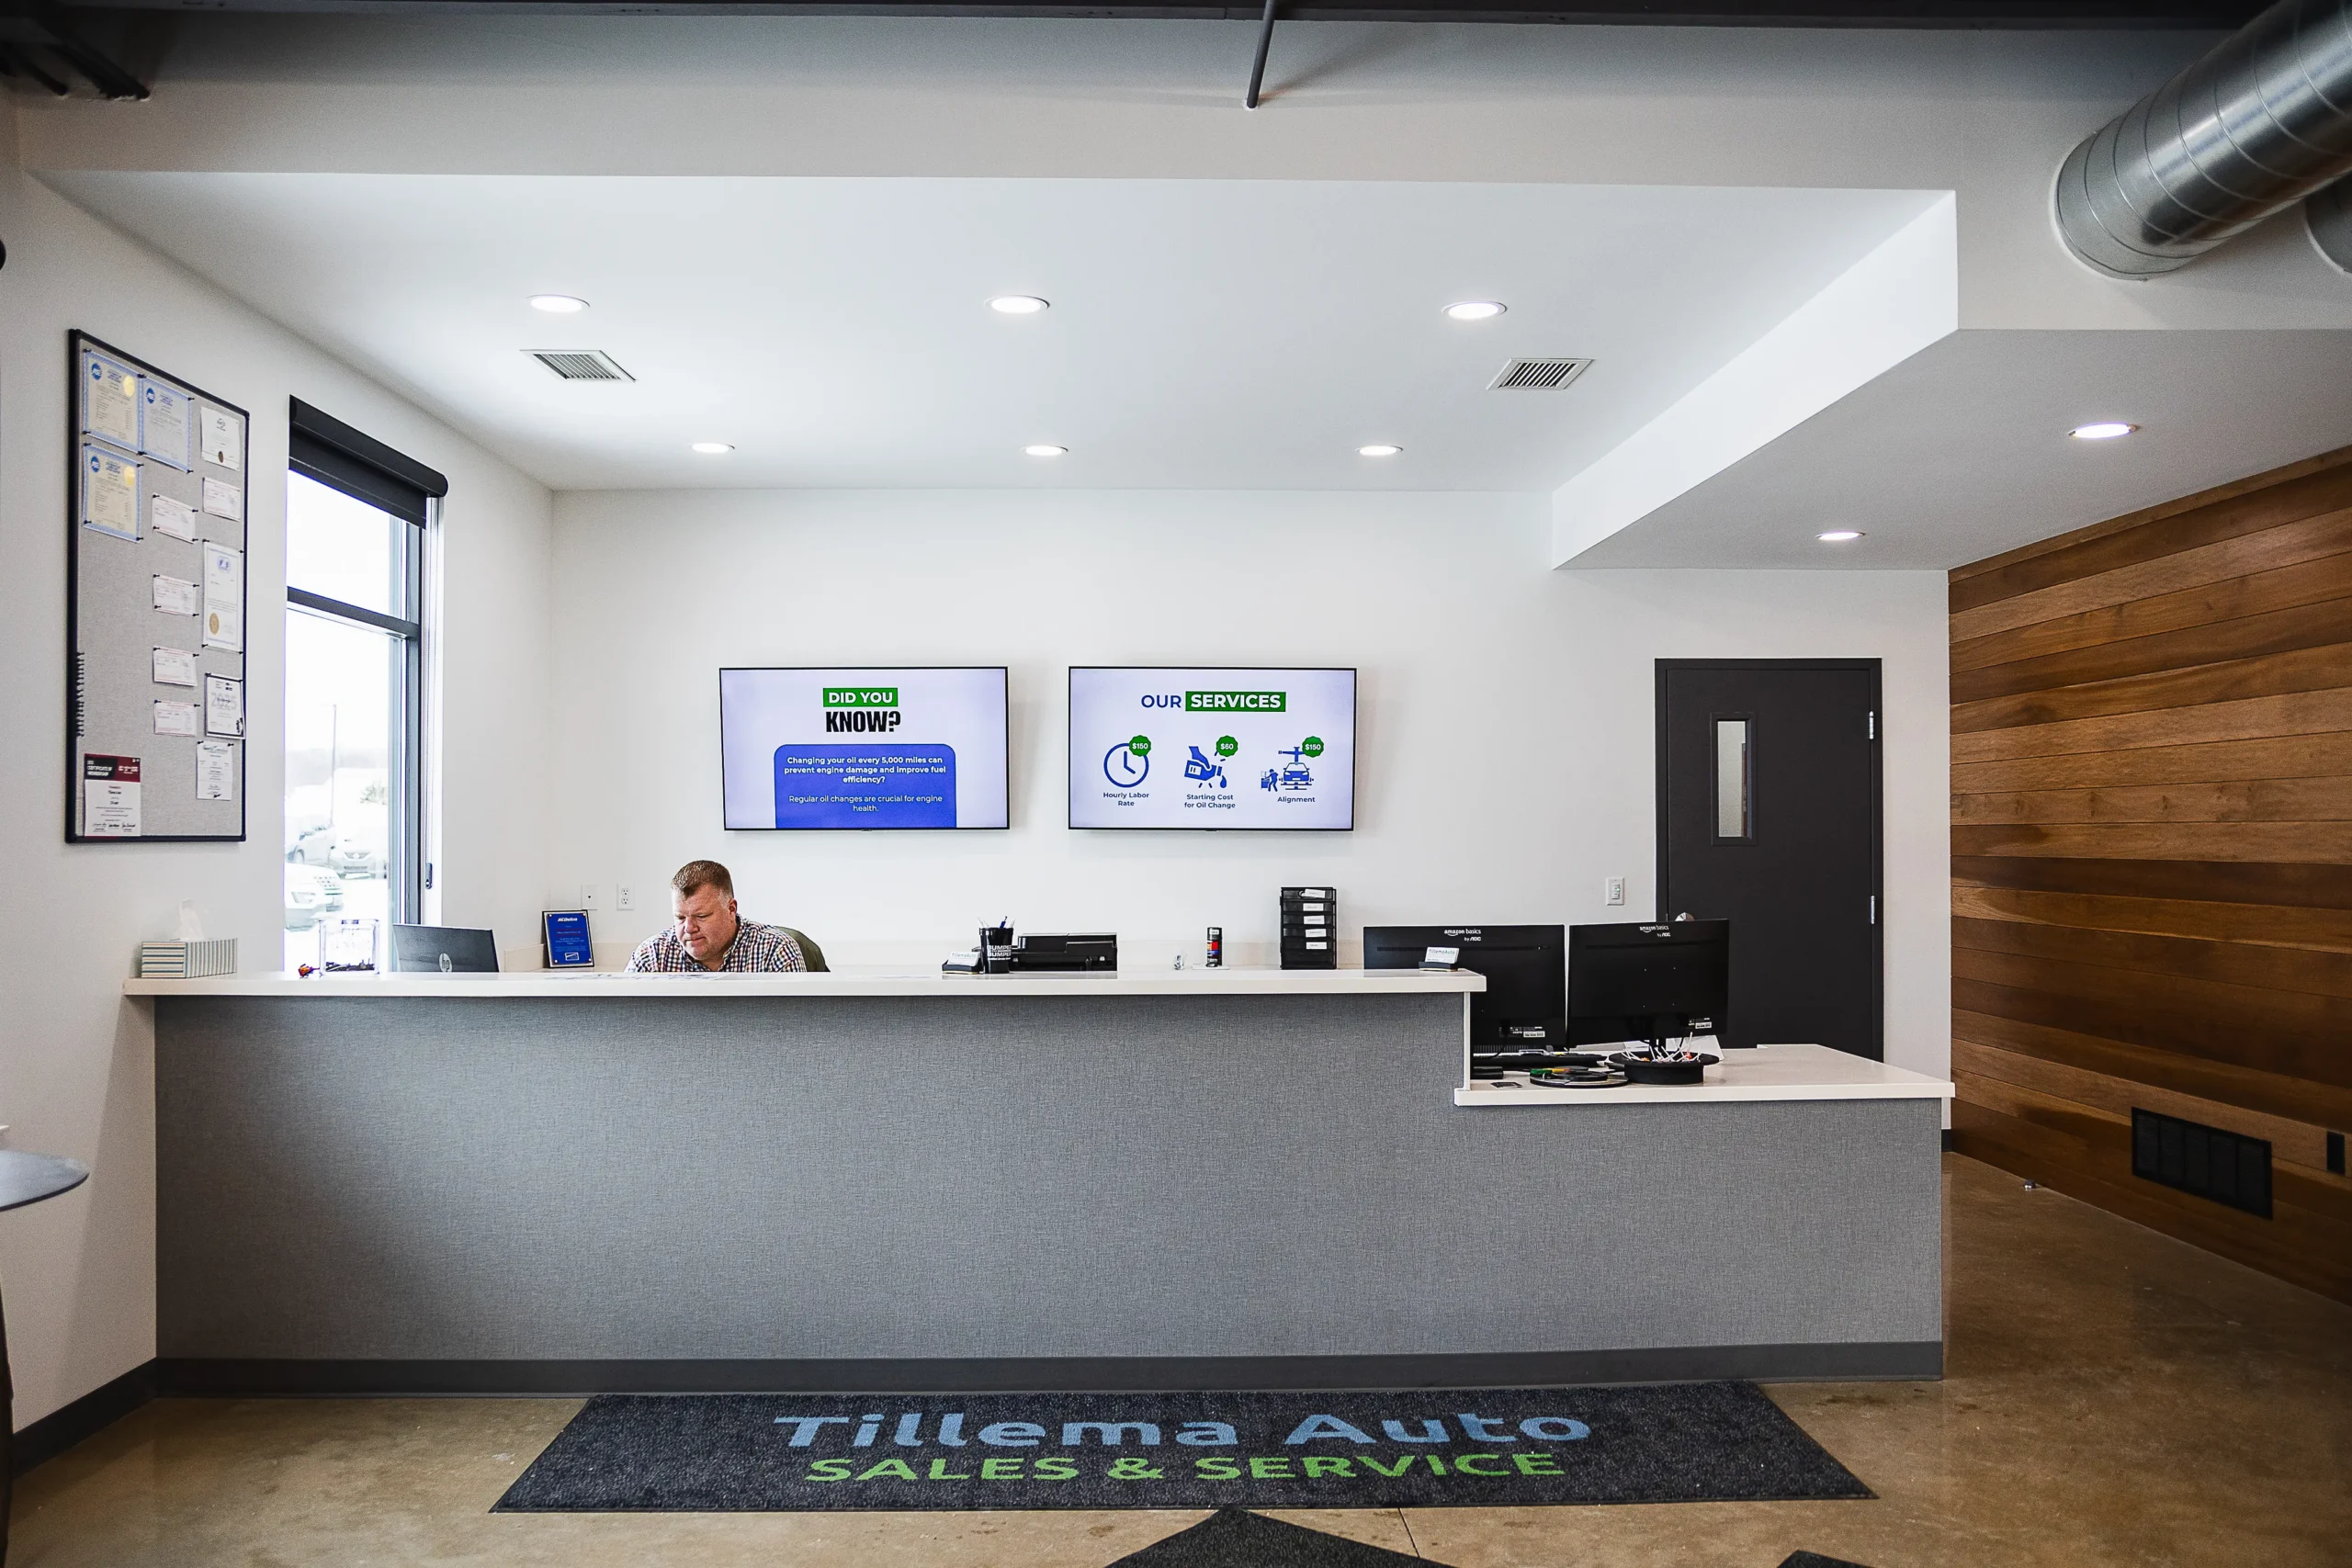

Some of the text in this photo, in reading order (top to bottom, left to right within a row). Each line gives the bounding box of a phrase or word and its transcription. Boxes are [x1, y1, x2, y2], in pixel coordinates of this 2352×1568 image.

[829, 692, 893, 704] DID YOU
[1141, 694, 1281, 708] OUR SERVICES
[825, 710, 901, 733] KNOW?
[786, 756, 825, 765] Changing
[846, 756, 856, 764] oil
[881, 756, 904, 764] 5,000
[784, 767, 815, 775] prevent
[816, 766, 844, 775] engine
[845, 766, 878, 774] damage
[896, 765, 930, 774] improve
[931, 765, 946, 773] fuel
[842, 775, 886, 784] efficiency?
[788, 795, 819, 804] Regular
[830, 795, 863, 804] changes
[915, 795, 944, 804] engine
[441, 953, 450, 972] hp
[774, 1413, 1591, 1448] Tillema Auto
[805, 1453, 1566, 1482] SALES & SERVICE
